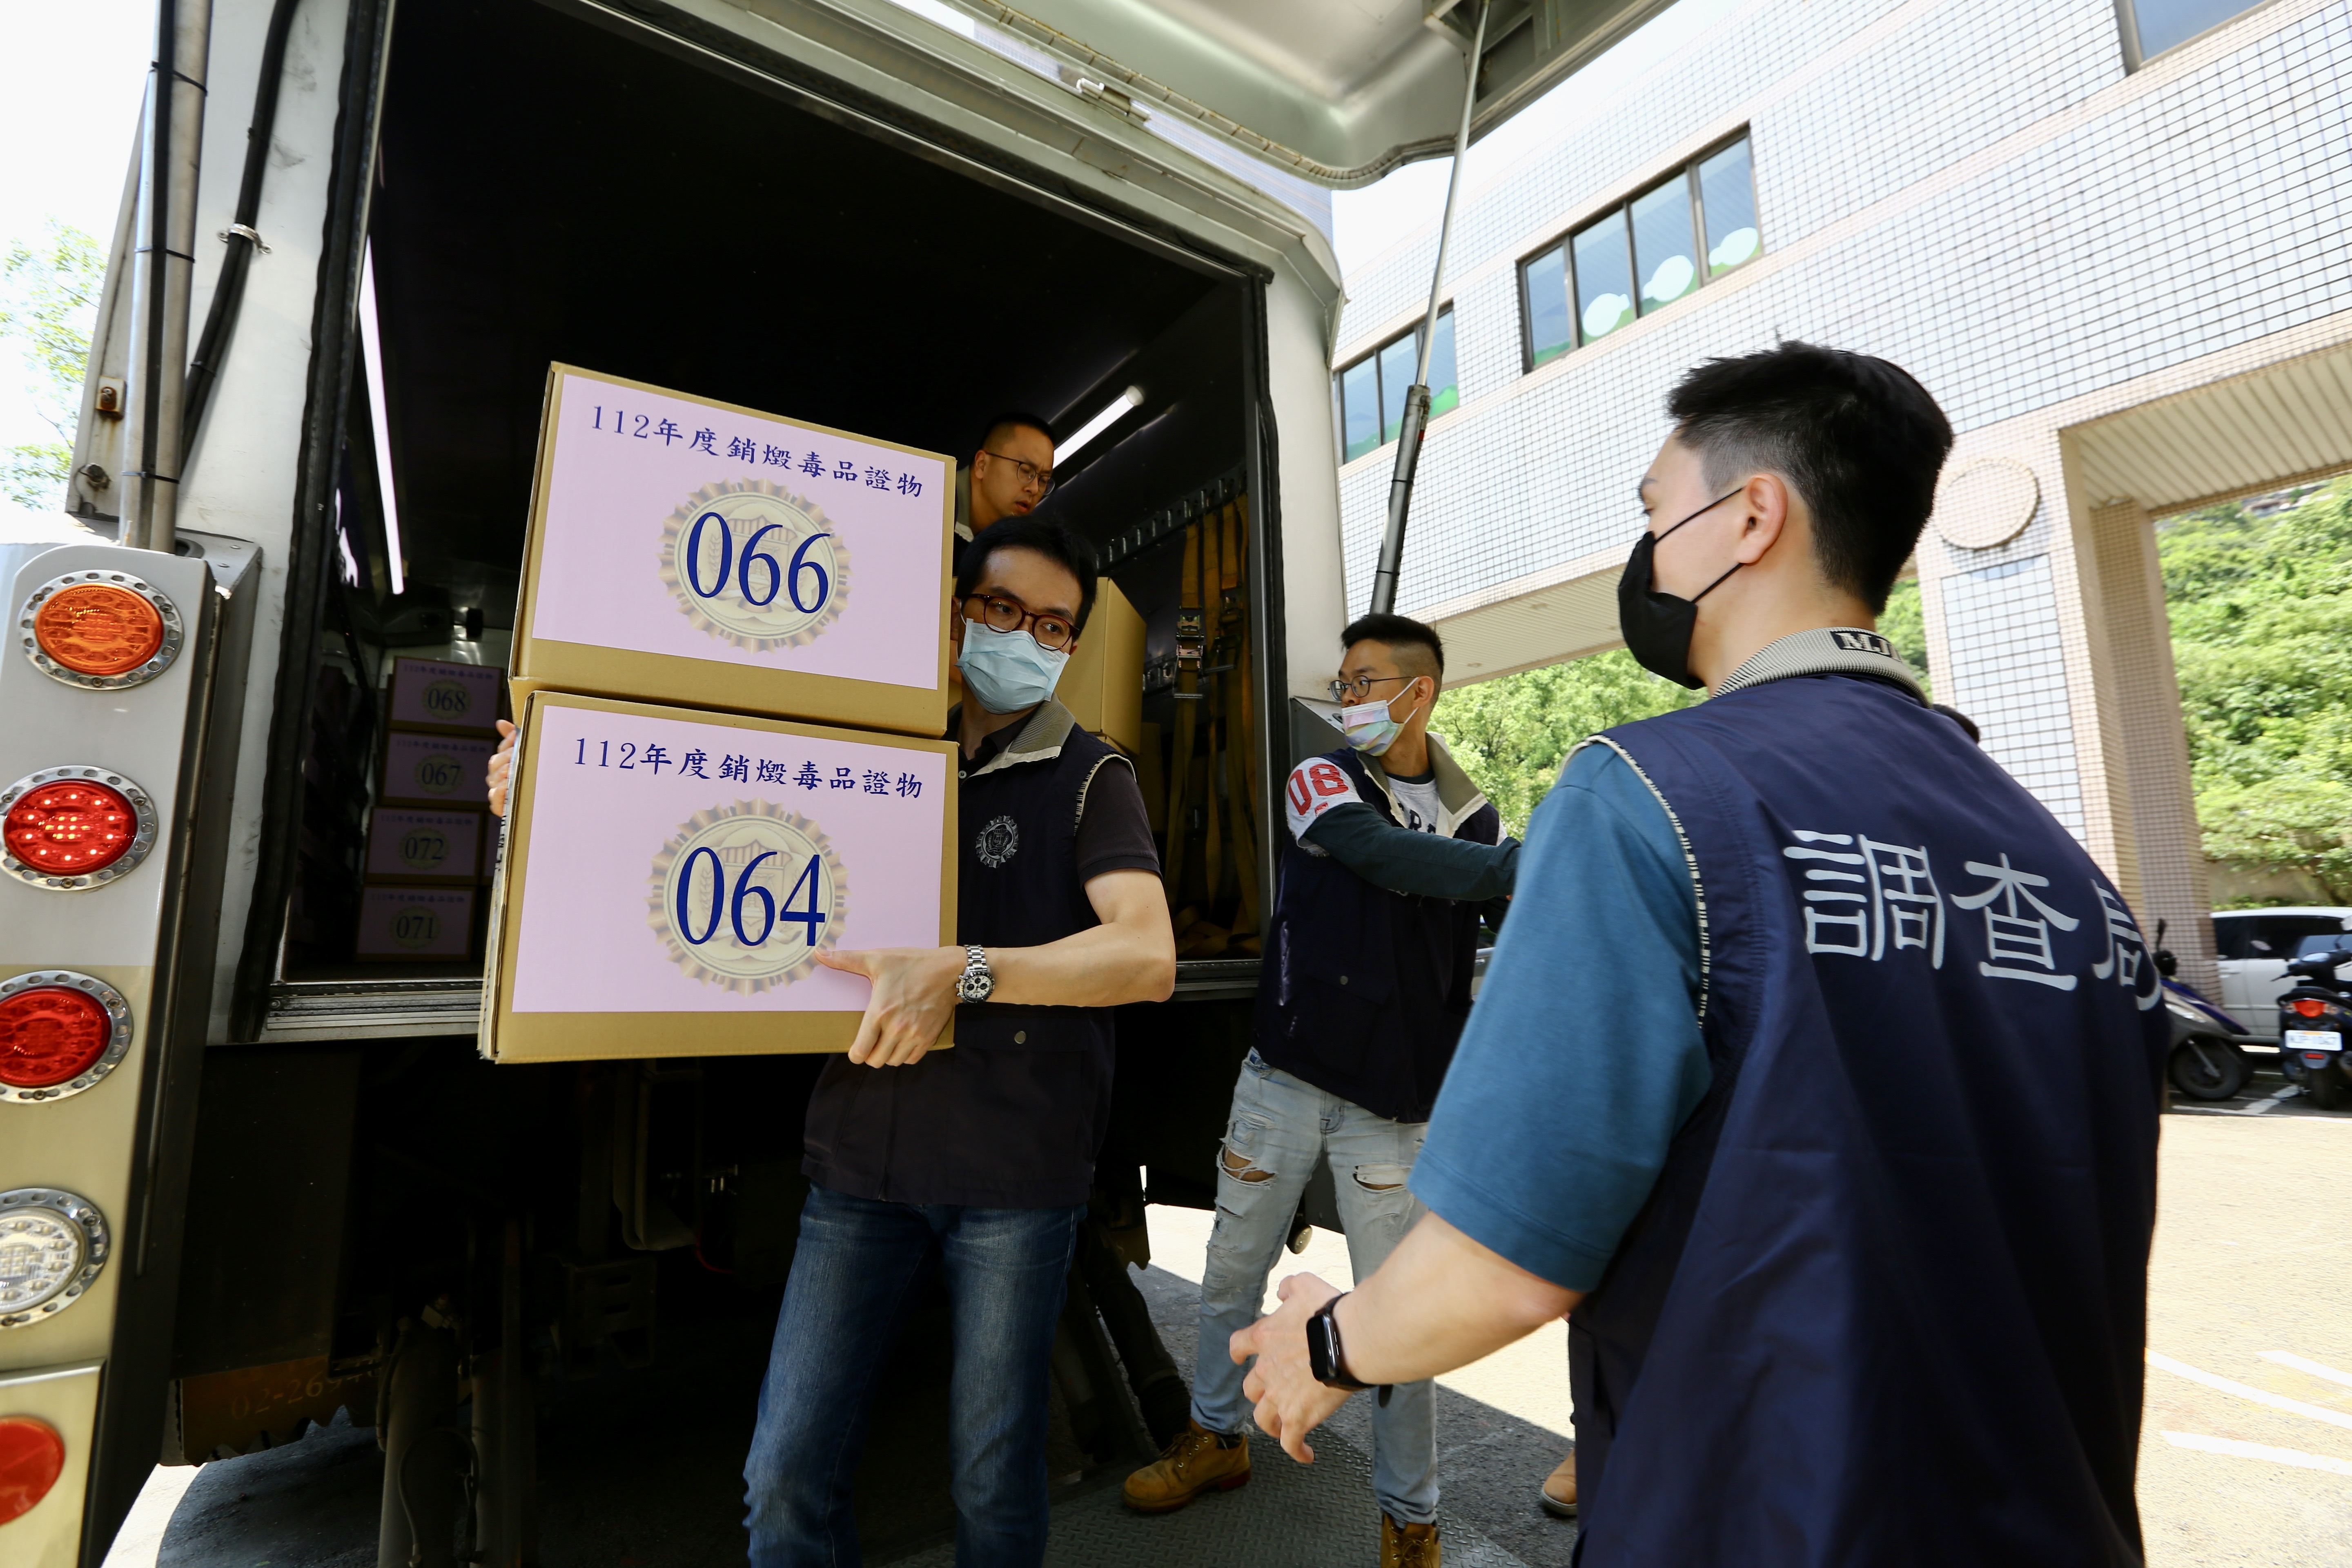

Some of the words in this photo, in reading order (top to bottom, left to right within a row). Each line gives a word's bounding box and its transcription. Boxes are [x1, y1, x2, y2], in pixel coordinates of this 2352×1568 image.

[591, 405, 922, 497] 112年度銷燬毒品證物
[686, 512, 830, 613] 066
[428, 688, 466, 712] 068
[422, 763, 461, 786] 067
[574, 737, 922, 799] 112年度銷燬毒品證物
[405, 837, 444, 860] 072
[396, 915, 434, 939] 071
[676, 847, 825, 946] 064
[1783, 830, 2161, 1011] 調查局
